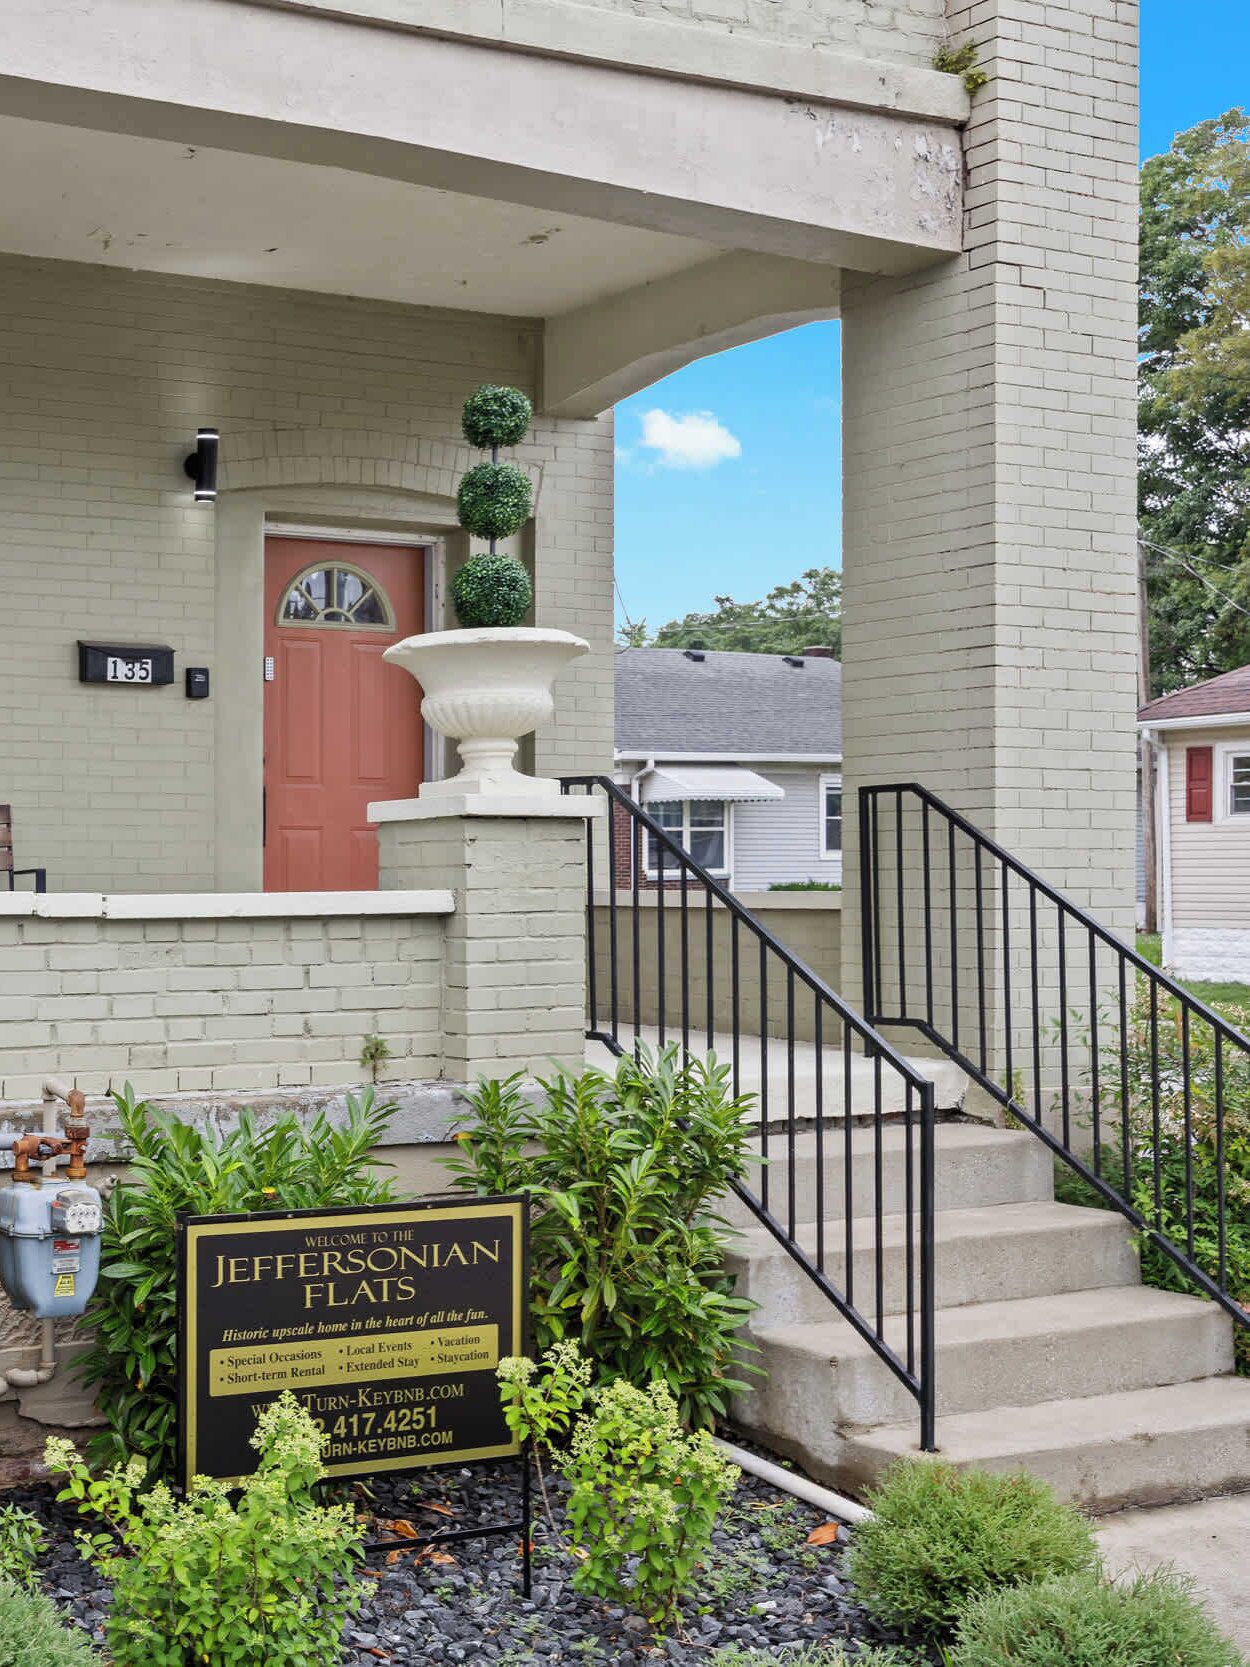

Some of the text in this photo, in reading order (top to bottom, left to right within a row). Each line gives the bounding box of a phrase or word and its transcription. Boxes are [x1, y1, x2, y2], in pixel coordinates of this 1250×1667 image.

[111, 659, 150, 680] 135
[305, 1229, 415, 1247] WELCOME TO THE
[210, 1239, 500, 1288] JEFFERSONIAN
[303, 1276, 416, 1309] FLATS
[222, 1308, 489, 1342] Historic upscale home in the heart of all the fun.
[346, 1341, 412, 1356] Local Events
[437, 1335, 481, 1347] Vacation
[227, 1349, 322, 1369] Special Occasions
[346, 1356, 420, 1373] Extended Stay
[437, 1349, 490, 1365] Staycation
[227, 1364, 325, 1385] Short-term Rental
